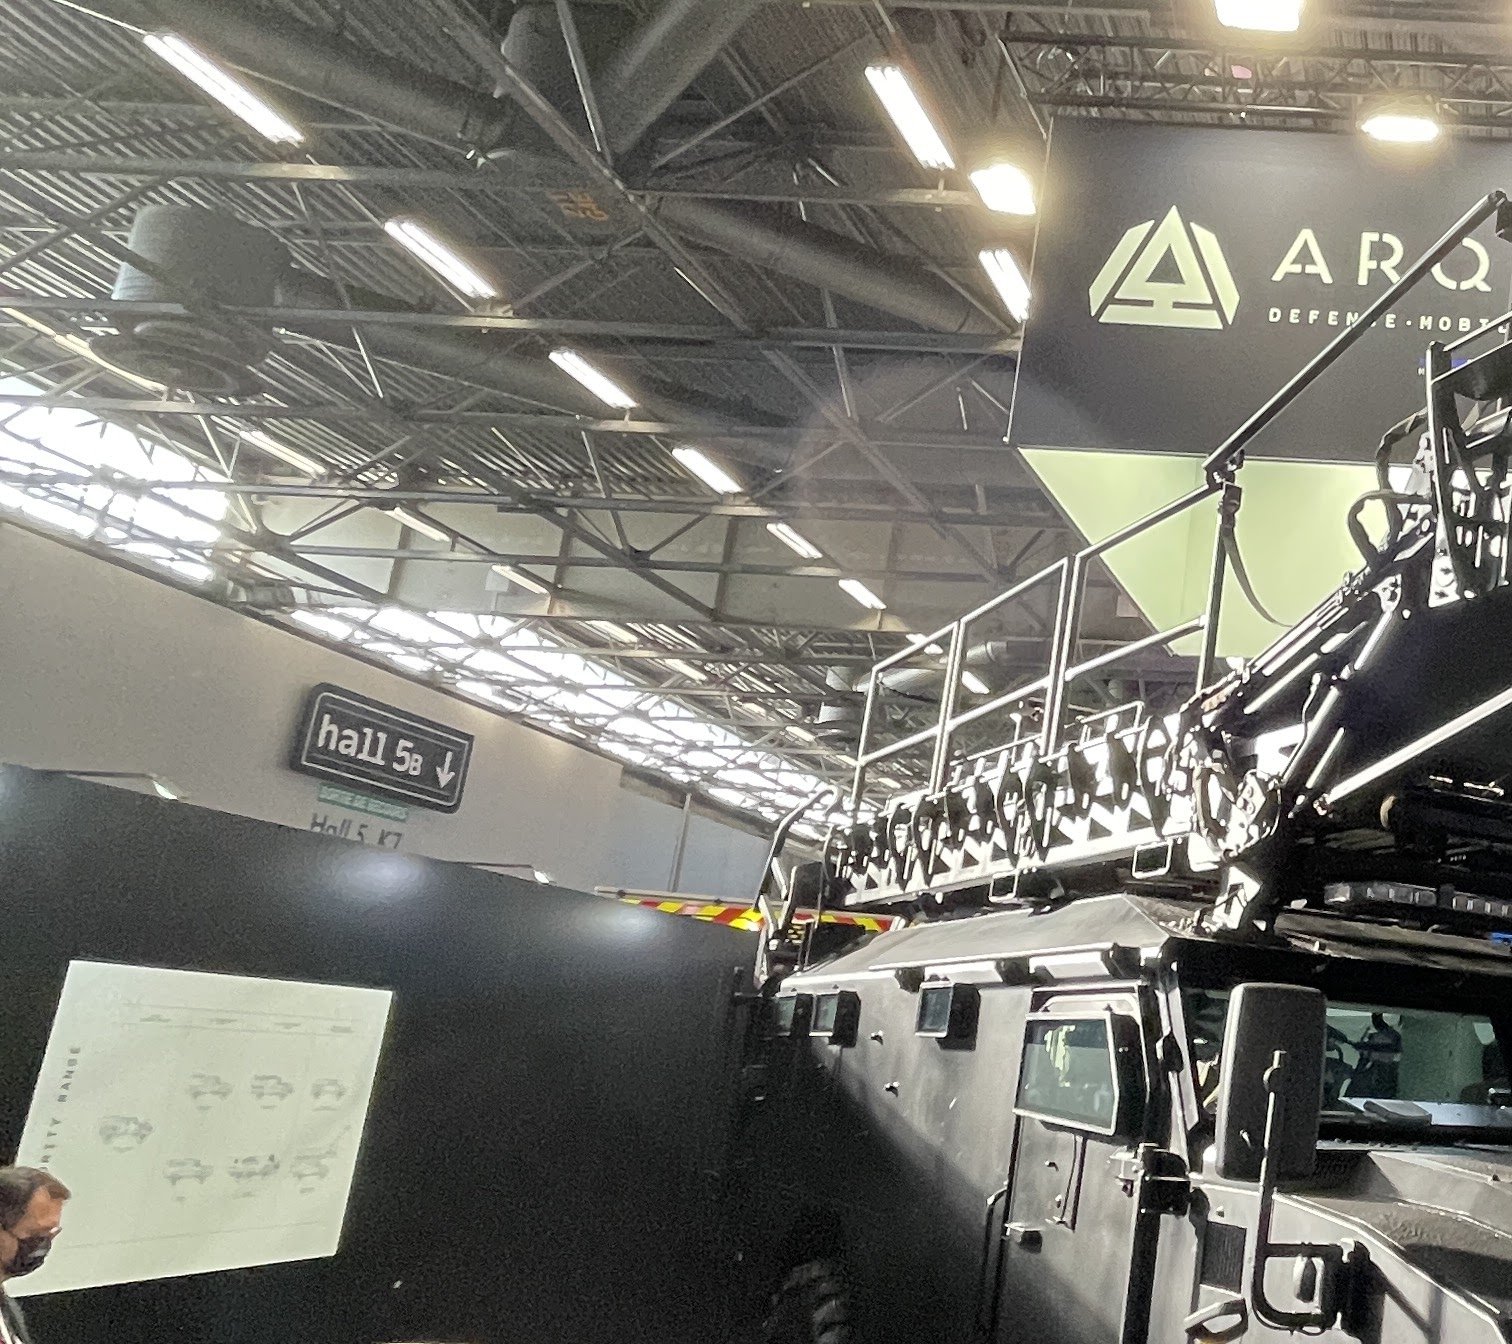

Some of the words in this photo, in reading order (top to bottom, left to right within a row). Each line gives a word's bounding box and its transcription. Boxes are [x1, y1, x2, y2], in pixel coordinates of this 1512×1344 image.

[1269, 307, 1396, 329] DEFENE
[318, 714, 387, 766] hall
[392, 739, 423, 776] 5B
[311, 812, 352, 837] Hall
